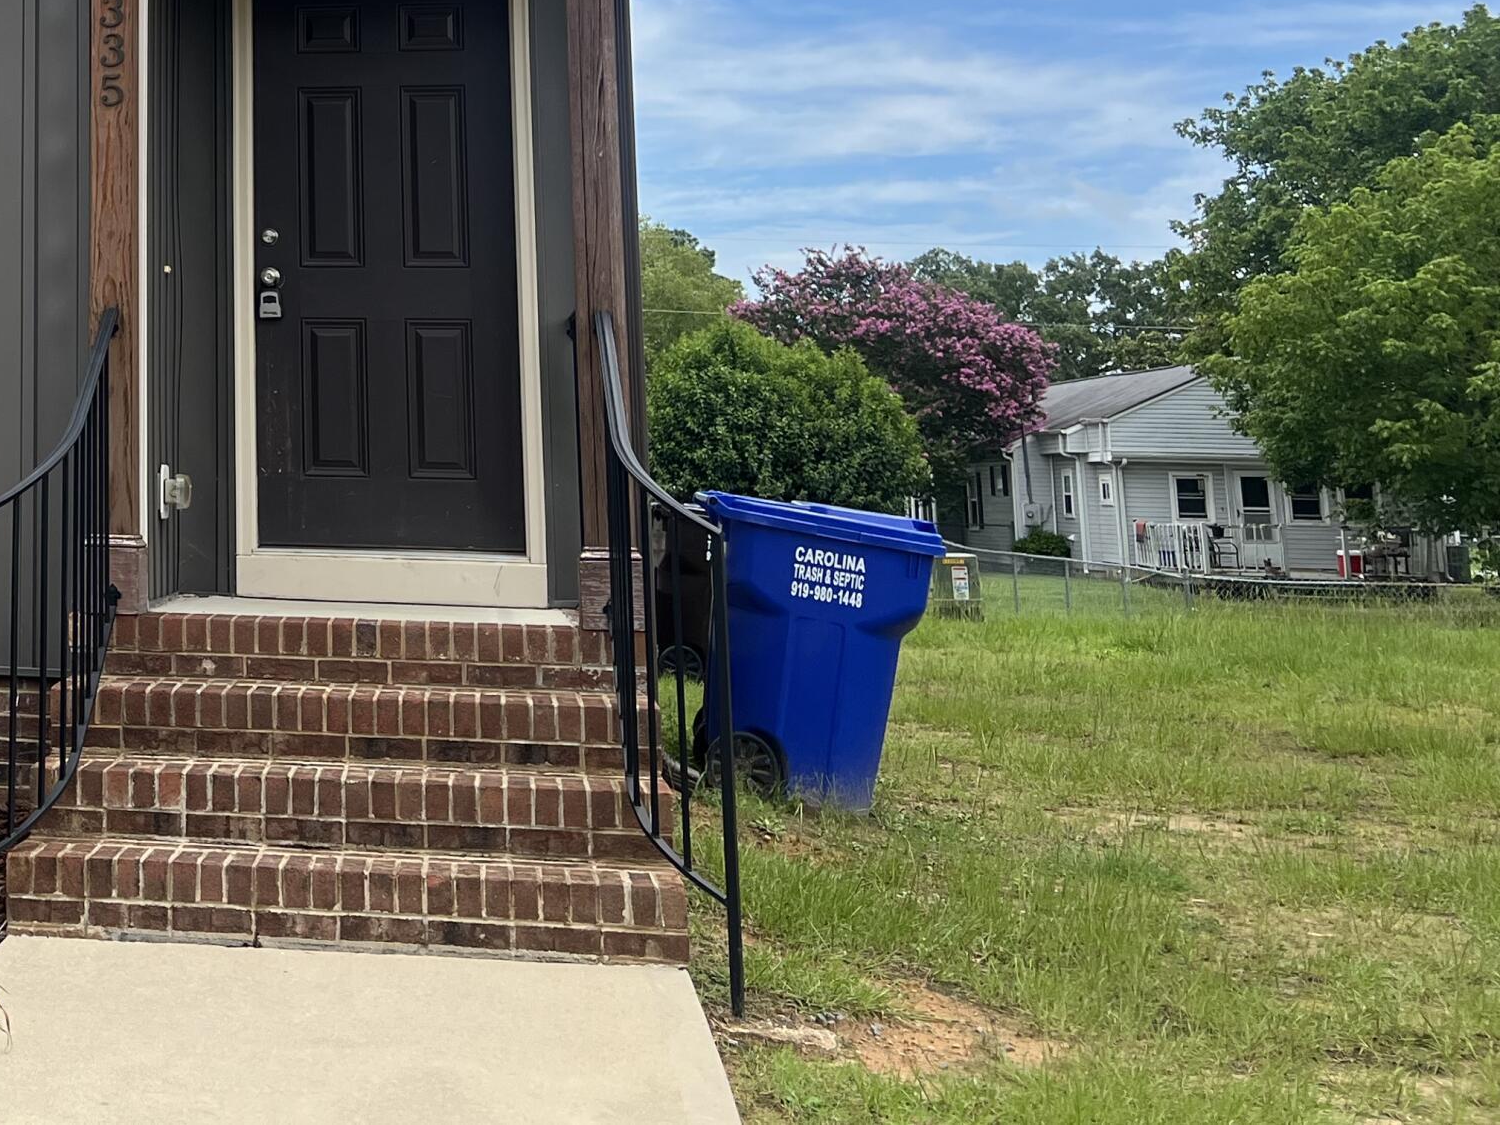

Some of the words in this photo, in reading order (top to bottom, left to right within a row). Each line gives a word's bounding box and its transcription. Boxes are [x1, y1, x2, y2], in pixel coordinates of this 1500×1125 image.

[795, 546, 866, 573] CAROLINA
[793, 563, 824, 583] TRASH
[824, 569, 832, 585] &
[832, 571, 865, 591] SEPTIC
[790, 581, 863, 608] 919-980-1448
